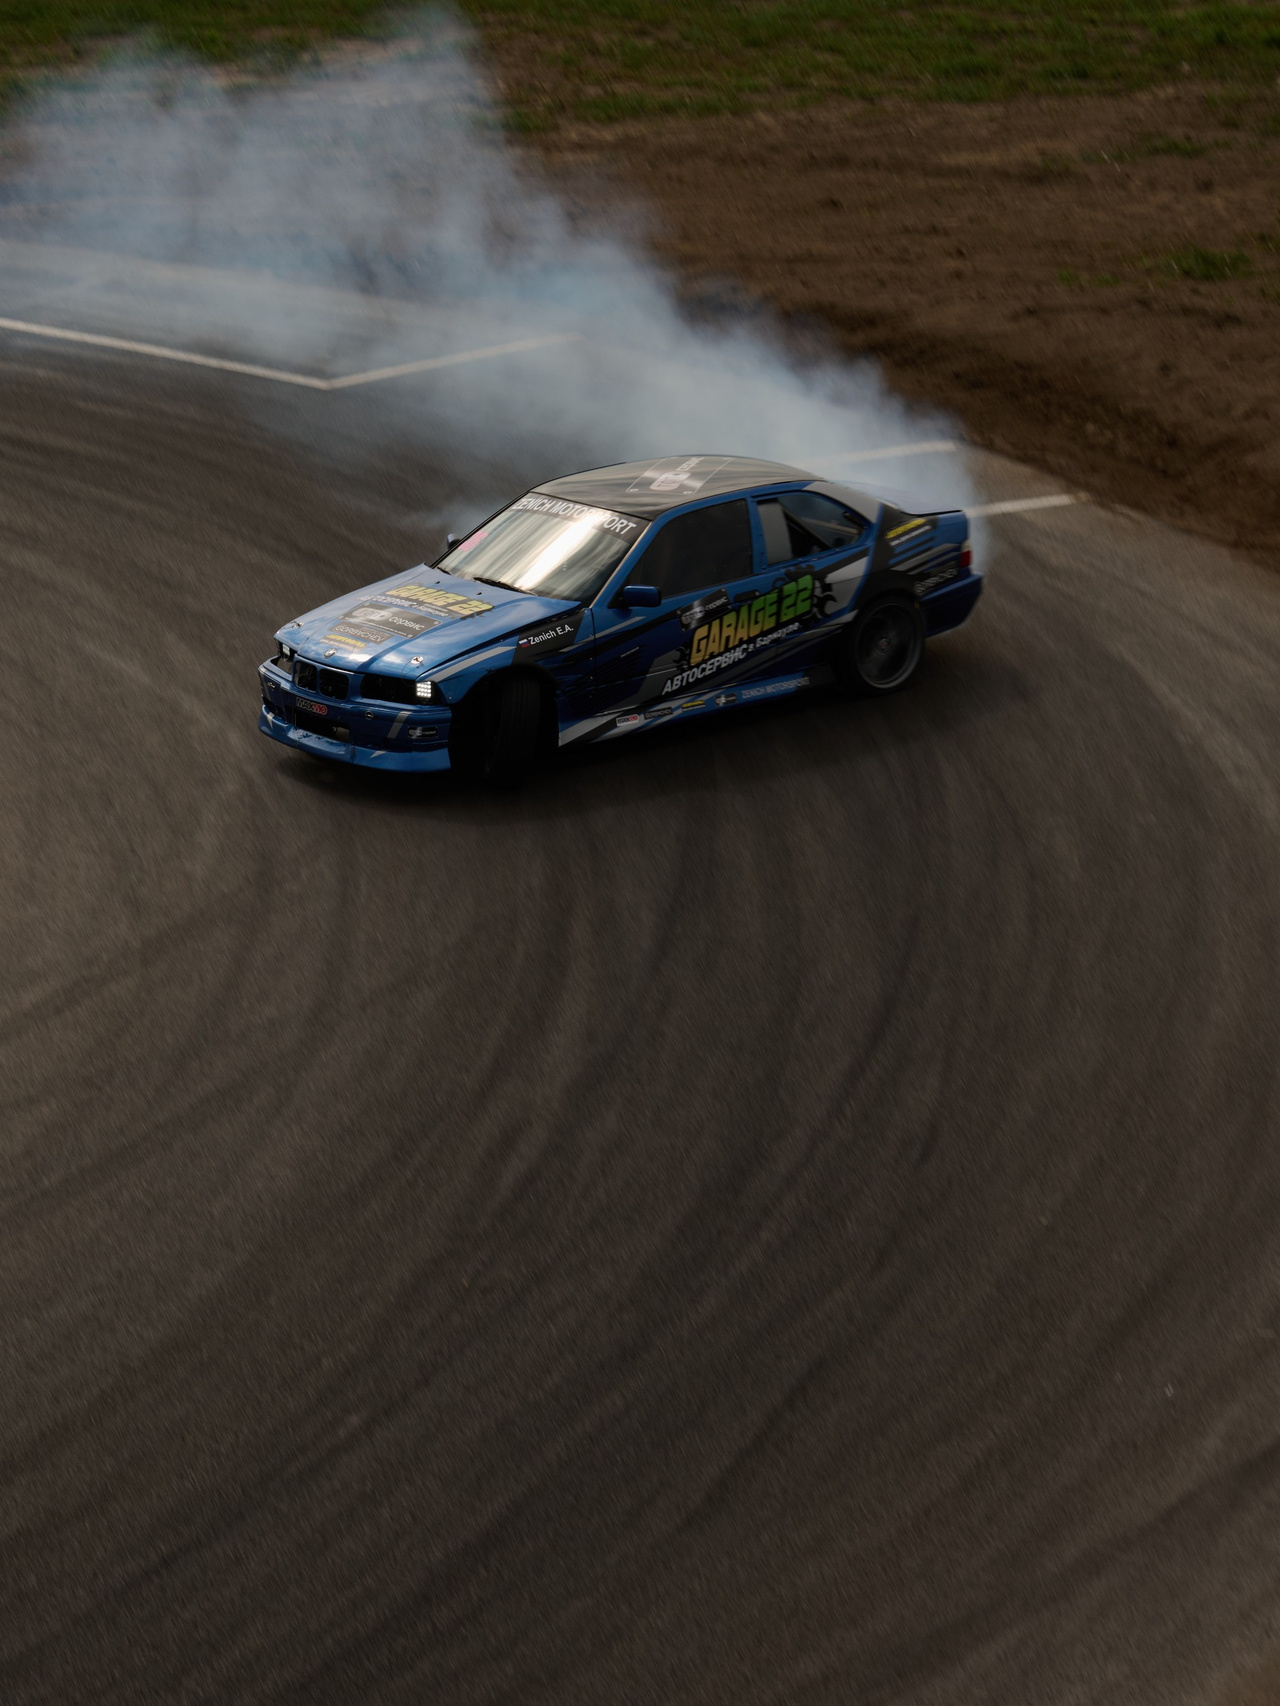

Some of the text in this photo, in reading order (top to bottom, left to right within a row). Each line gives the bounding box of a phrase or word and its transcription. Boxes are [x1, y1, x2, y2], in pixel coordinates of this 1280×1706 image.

[511, 498, 637, 534] ZENICH MOTORPORT
[447, 600, 494, 615] 22
[689, 574, 814, 667] GARAGE 22
[389, 616, 425, 631] сервис
[528, 624, 574, 645] Zenich E.A.
[661, 643, 748, 695] АВТОСЕРВИС
